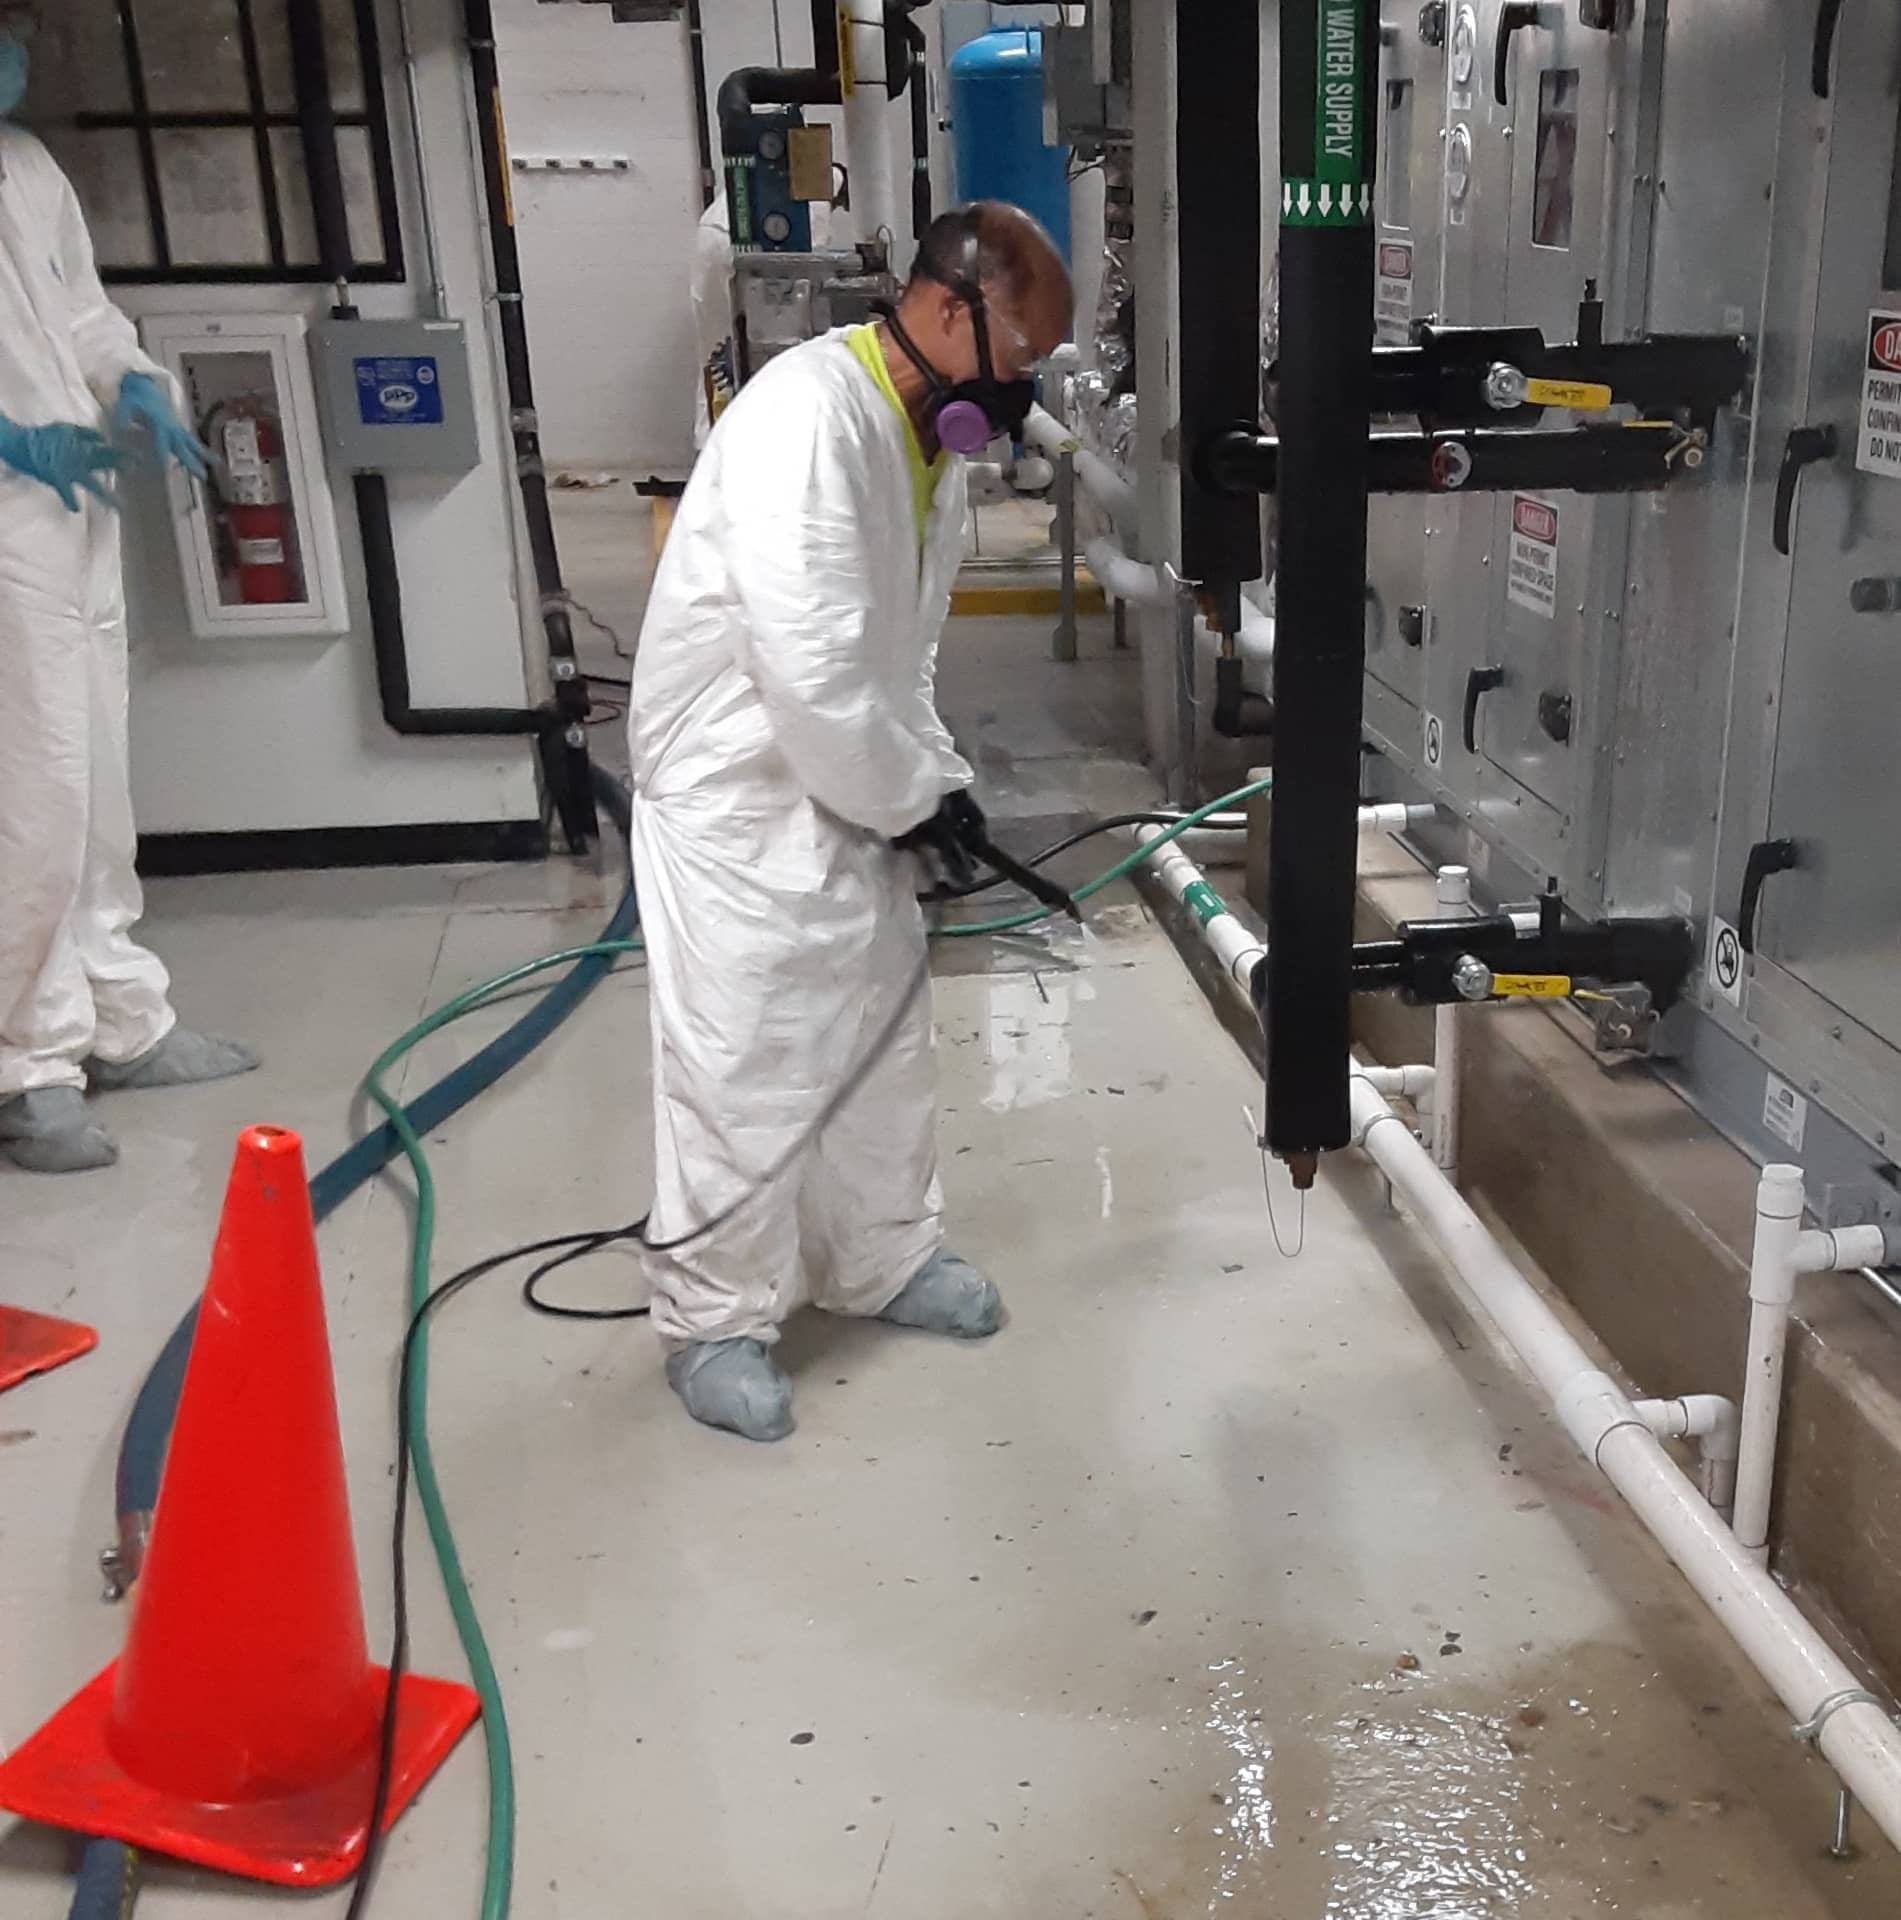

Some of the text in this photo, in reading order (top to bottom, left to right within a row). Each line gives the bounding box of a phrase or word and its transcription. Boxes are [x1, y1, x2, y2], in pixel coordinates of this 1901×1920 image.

[1325, 9, 1355, 159] WATER SUPPLY
[1870, 437, 1884, 458] DO
